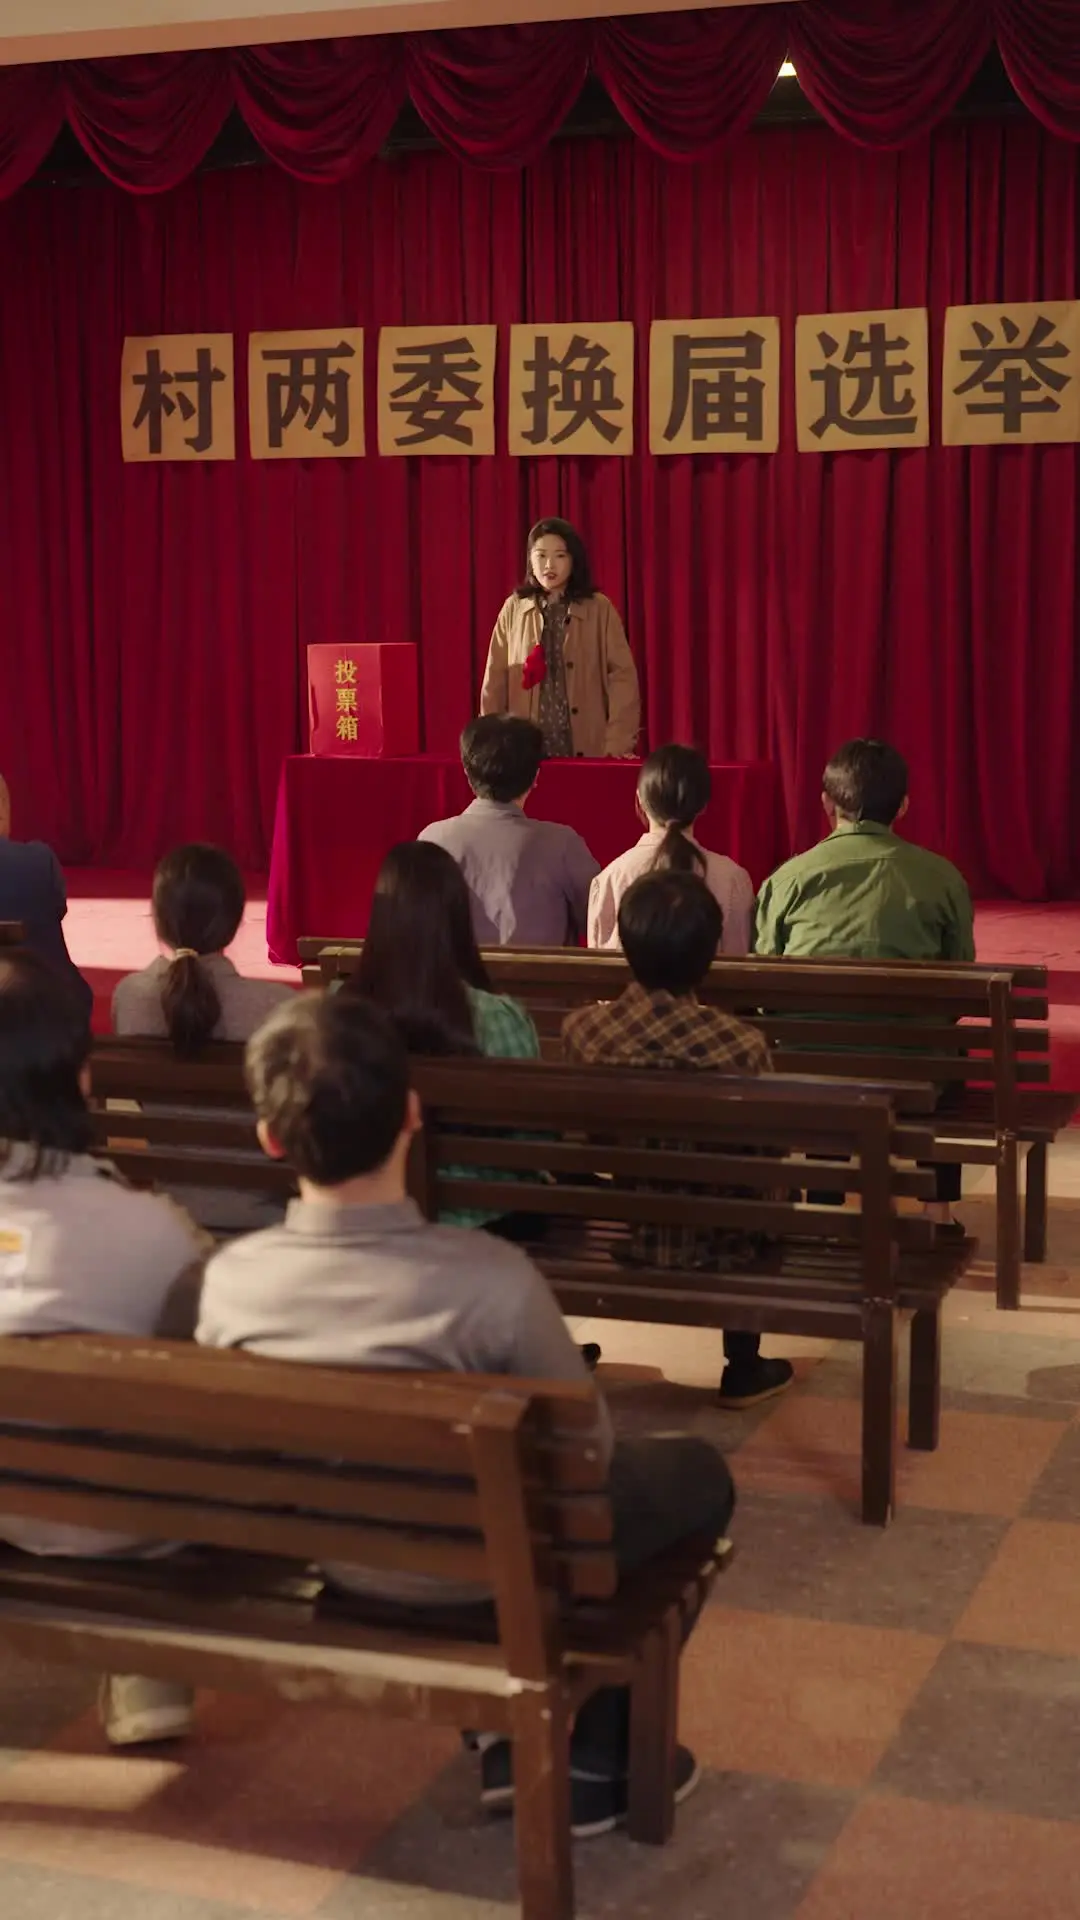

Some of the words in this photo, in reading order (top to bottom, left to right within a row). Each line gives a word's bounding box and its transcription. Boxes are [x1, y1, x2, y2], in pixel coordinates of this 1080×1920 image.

[132, 316, 1073, 454] 村两委换届选举
[334, 659, 358, 741] 投票箱
